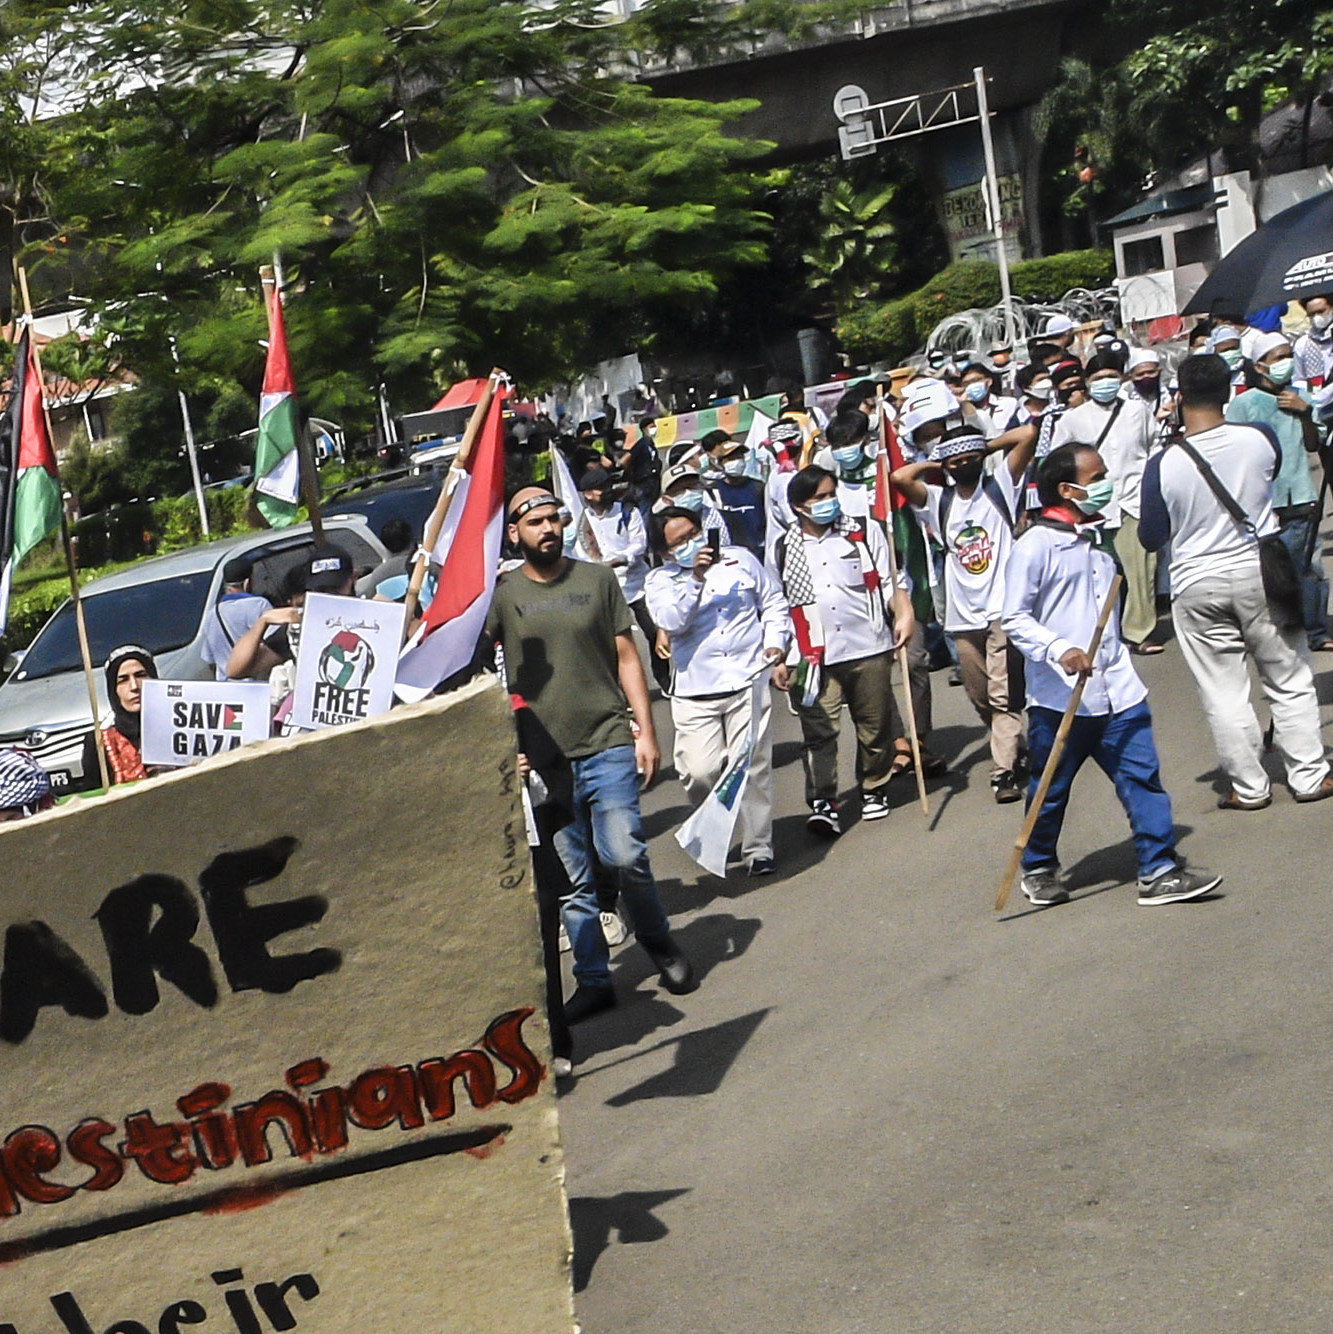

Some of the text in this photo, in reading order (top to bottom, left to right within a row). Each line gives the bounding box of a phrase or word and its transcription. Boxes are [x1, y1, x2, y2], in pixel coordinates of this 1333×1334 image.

[313, 681, 370, 717] FREE
[173, 701, 243, 731] SAVE
[312, 709, 361, 726] PALESTI
[173, 731, 242, 758] GAZA
